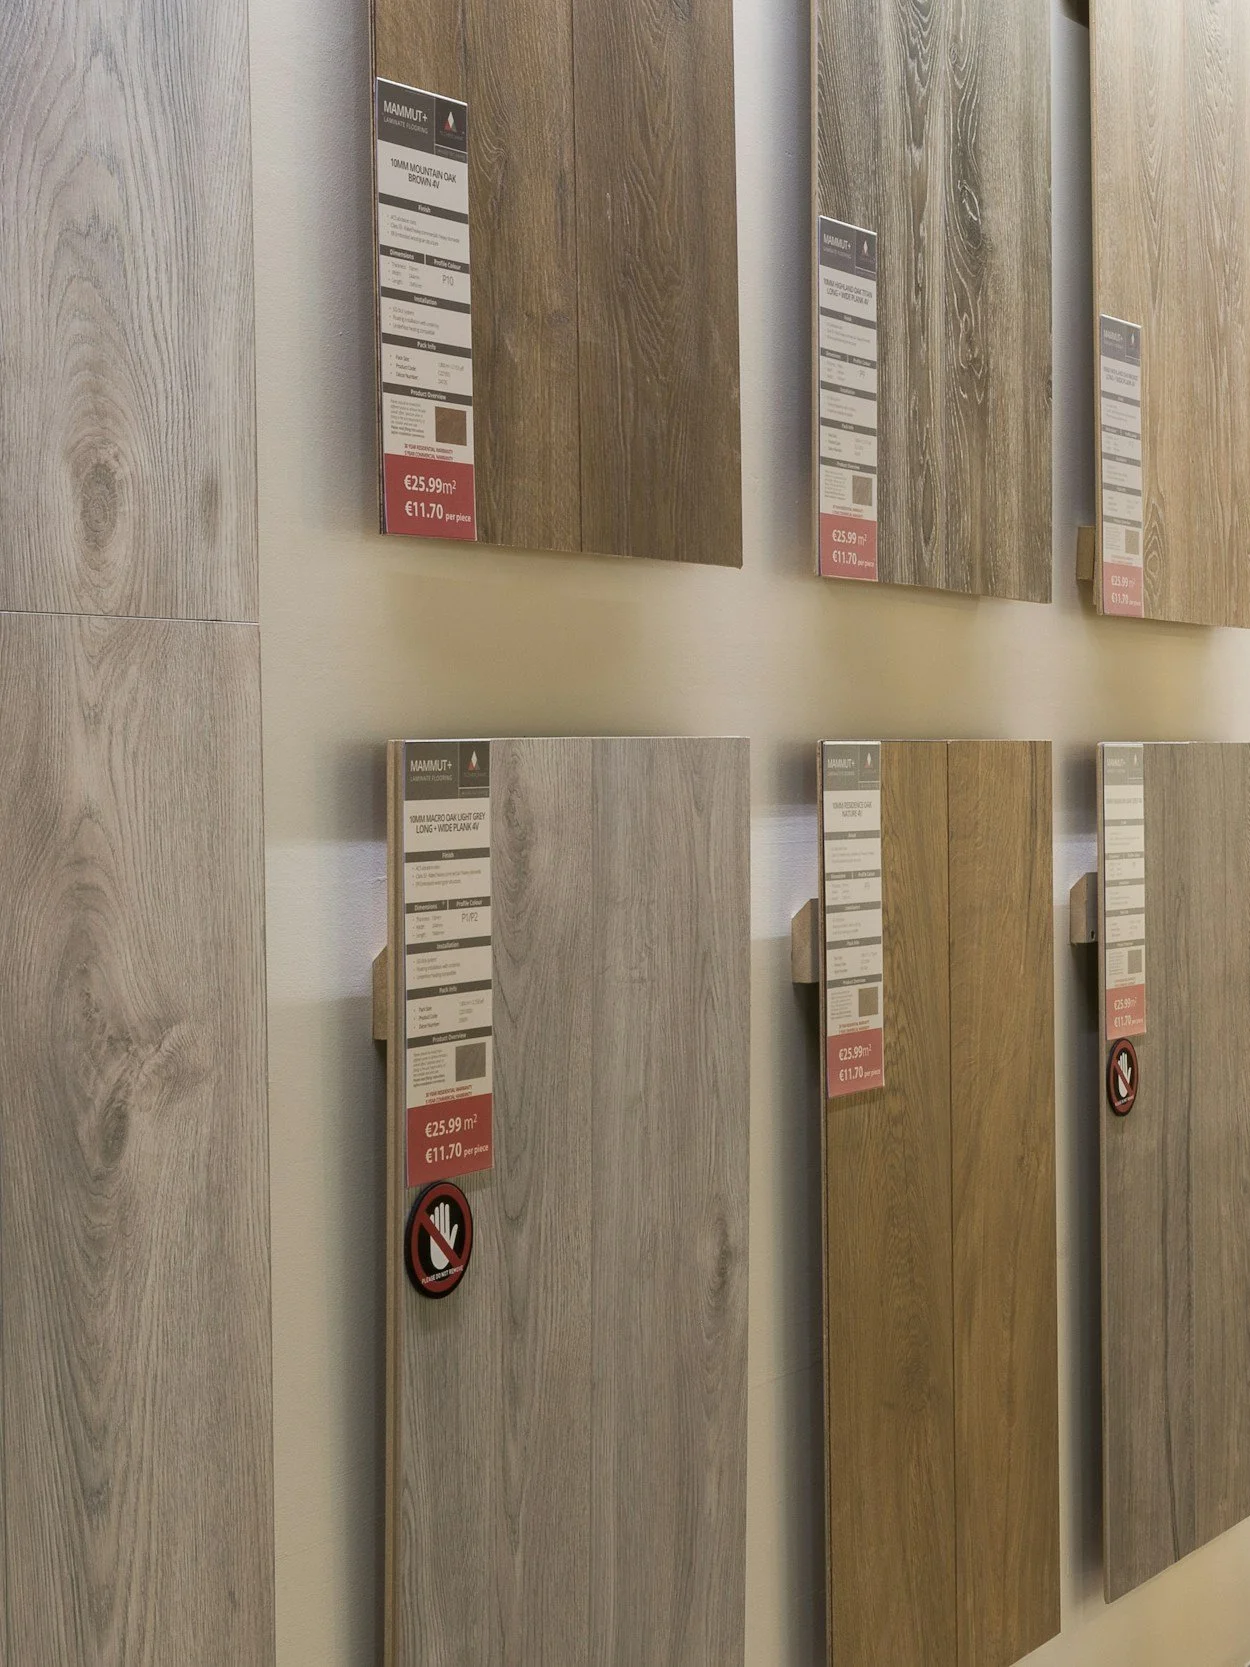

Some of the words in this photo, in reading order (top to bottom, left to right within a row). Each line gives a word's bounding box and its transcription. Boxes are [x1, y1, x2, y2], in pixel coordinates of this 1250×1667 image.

[383, 100, 428, 122] MAMMUT+
[390, 158, 409, 170] 10MM
[409, 163, 443, 180] MOUNTAIN
[443, 172, 457, 183] OAK
[408, 174, 432, 187] BROWN
[432, 179, 440, 189] 4V
[442, 274, 454, 286] P10
[404, 500, 444, 520] €11.70
[445, 512, 456, 522] per
[456, 513, 472, 523] piece
[832, 529, 857, 544] €25.99
[832, 550, 858, 565] €11.70
[410, 760, 453, 772] MAMMUT+
[445, 813, 457, 822] OAK
[457, 812, 472, 821] LIGHT
[473, 812, 487, 820] GREY
[415, 824, 433, 834] LONG
[438, 823, 453, 833] WIDE
[453, 823, 472, 832] PLANK
[839, 1066, 864, 1081] €11.70
[425, 1116, 462, 1138] €25.99
[425, 1142, 462, 1164] €11.70
[463, 1148, 474, 1158] per
[474, 1143, 489, 1156] piece
